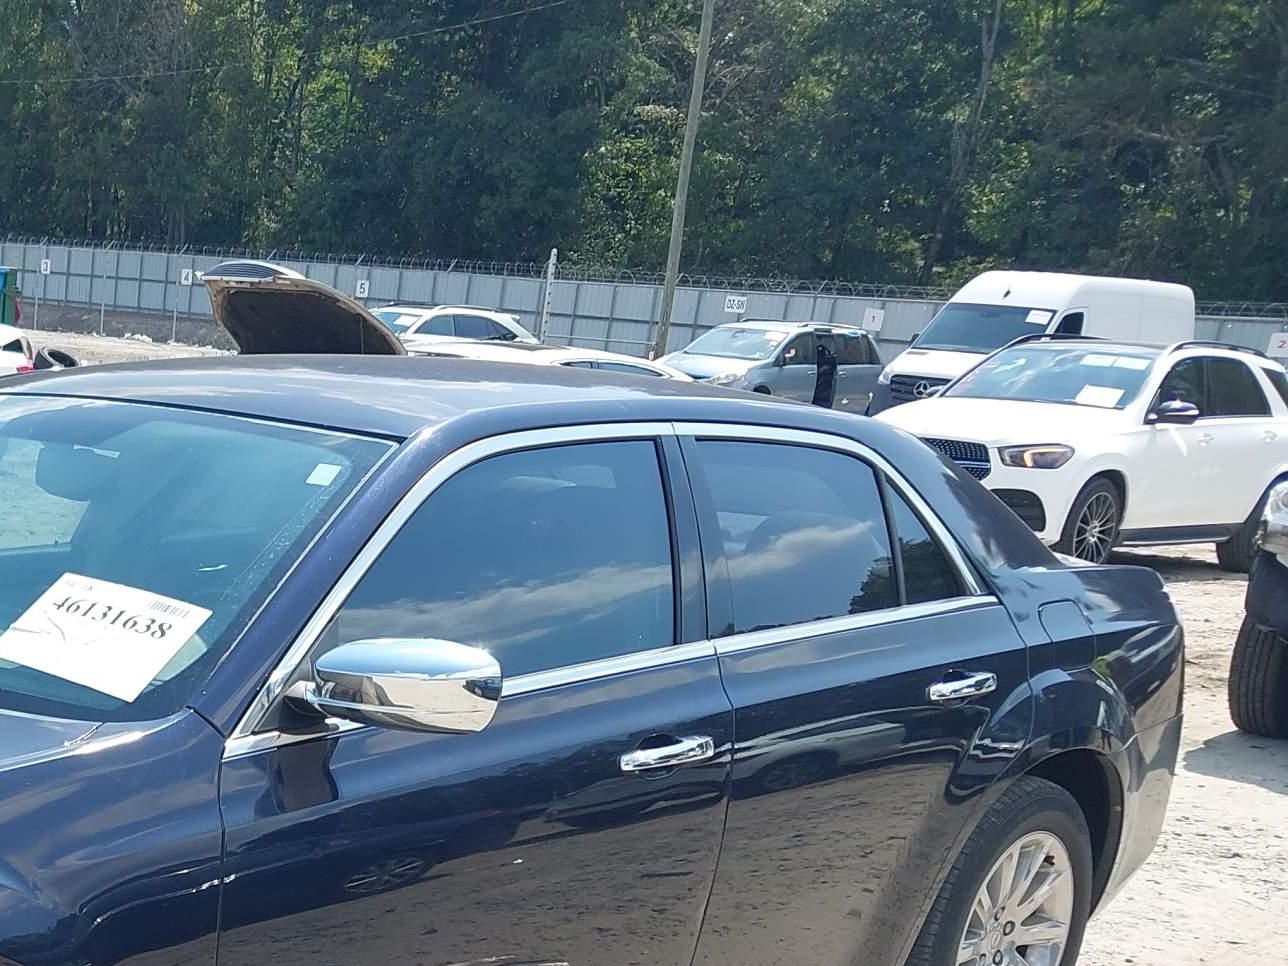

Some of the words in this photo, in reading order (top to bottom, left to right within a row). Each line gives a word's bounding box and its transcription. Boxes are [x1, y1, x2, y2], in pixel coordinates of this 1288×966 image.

[359, 282, 366, 294] 5
[1277, 339, 1287, 349] 2
[52, 596, 173, 640] 46131638
